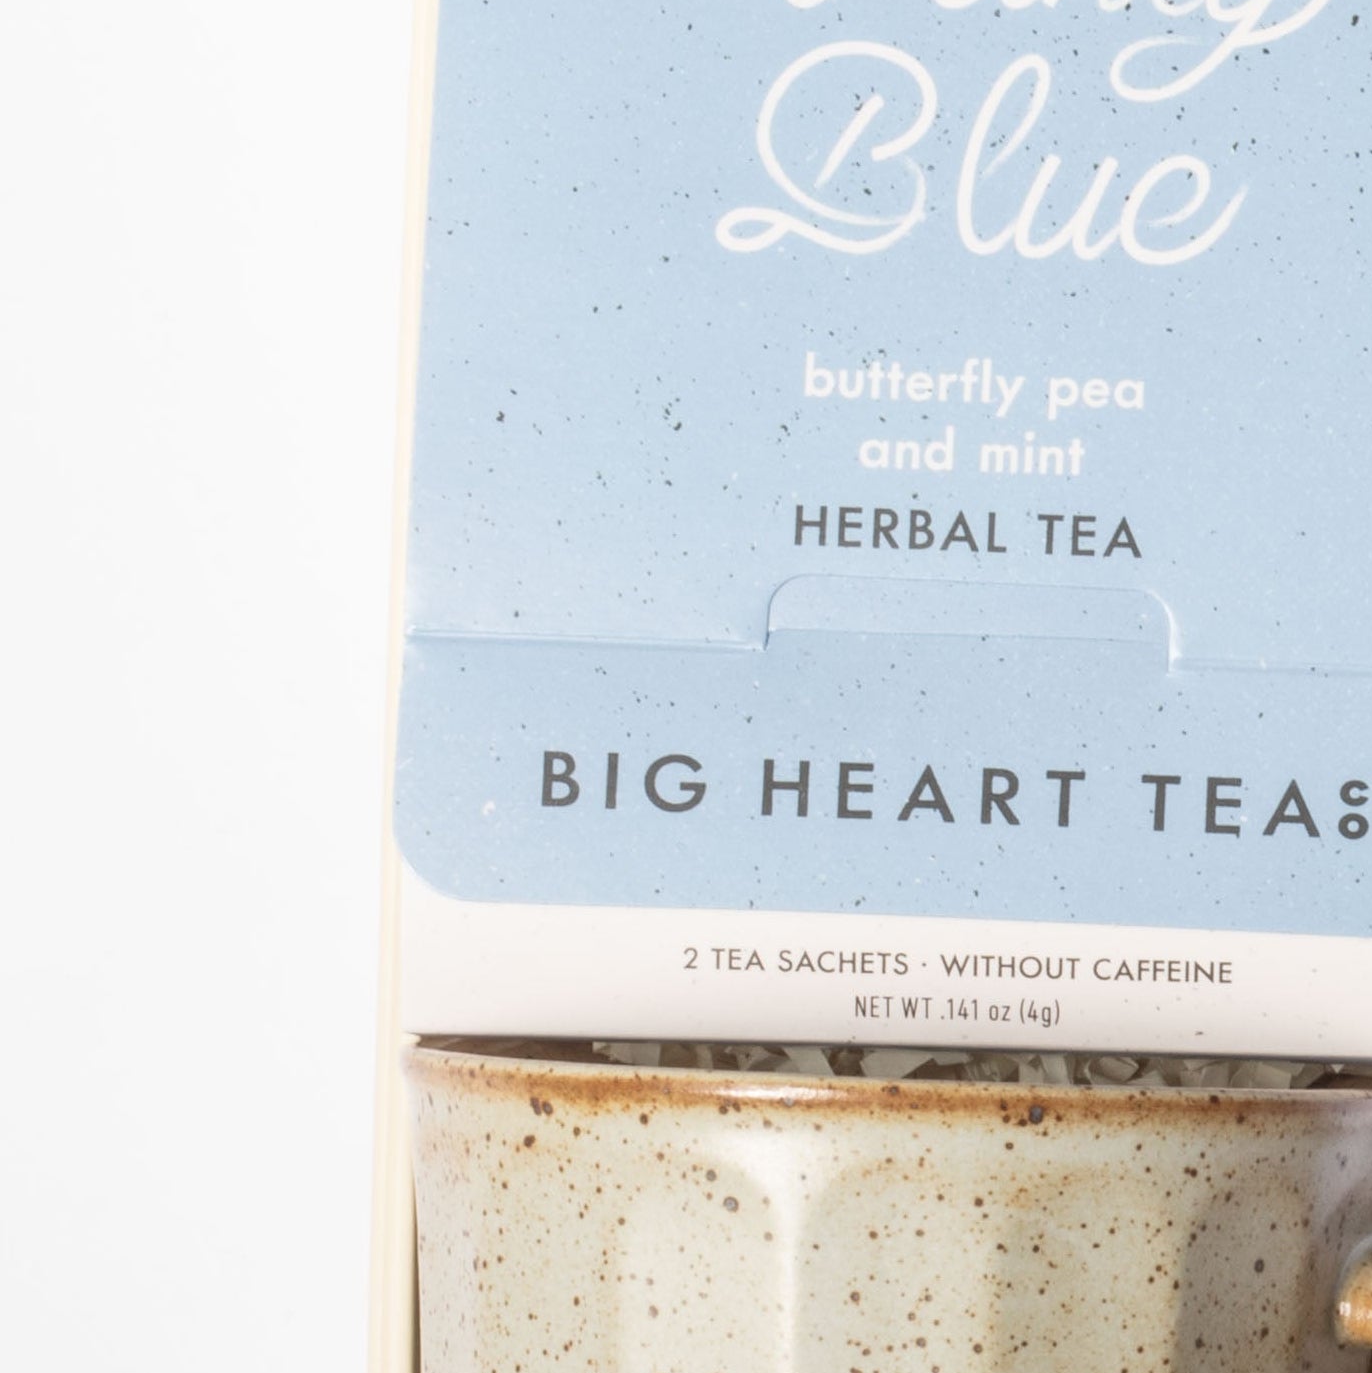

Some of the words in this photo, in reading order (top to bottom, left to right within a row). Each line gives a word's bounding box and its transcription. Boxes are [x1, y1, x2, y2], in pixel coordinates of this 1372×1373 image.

[716, 40, 1248, 265] Blue
[804, 352, 1025, 416] butterfly
[1048, 377, 1145, 420] pea
[859, 425, 954, 470] and
[980, 431, 1085, 475] mint
[794, 505, 1007, 553] HERBAL
[1038, 513, 1142, 557] TEA
[541, 750, 706, 812] BIG
[761, 758, 1085, 827] HEART
[684, 948, 698, 969] 2
[712, 948, 764, 970] TEA
[778, 950, 909, 974] SACHETS
[940, 954, 1080, 980] WITHOUT
[1093, 959, 1233, 984] CAFFEINE
[855, 996, 892, 1018] NET
[902, 998, 932, 1019] WT
[989, 1004, 1010, 1022] oz
[1018, 1000, 1060, 1027] (4g)
